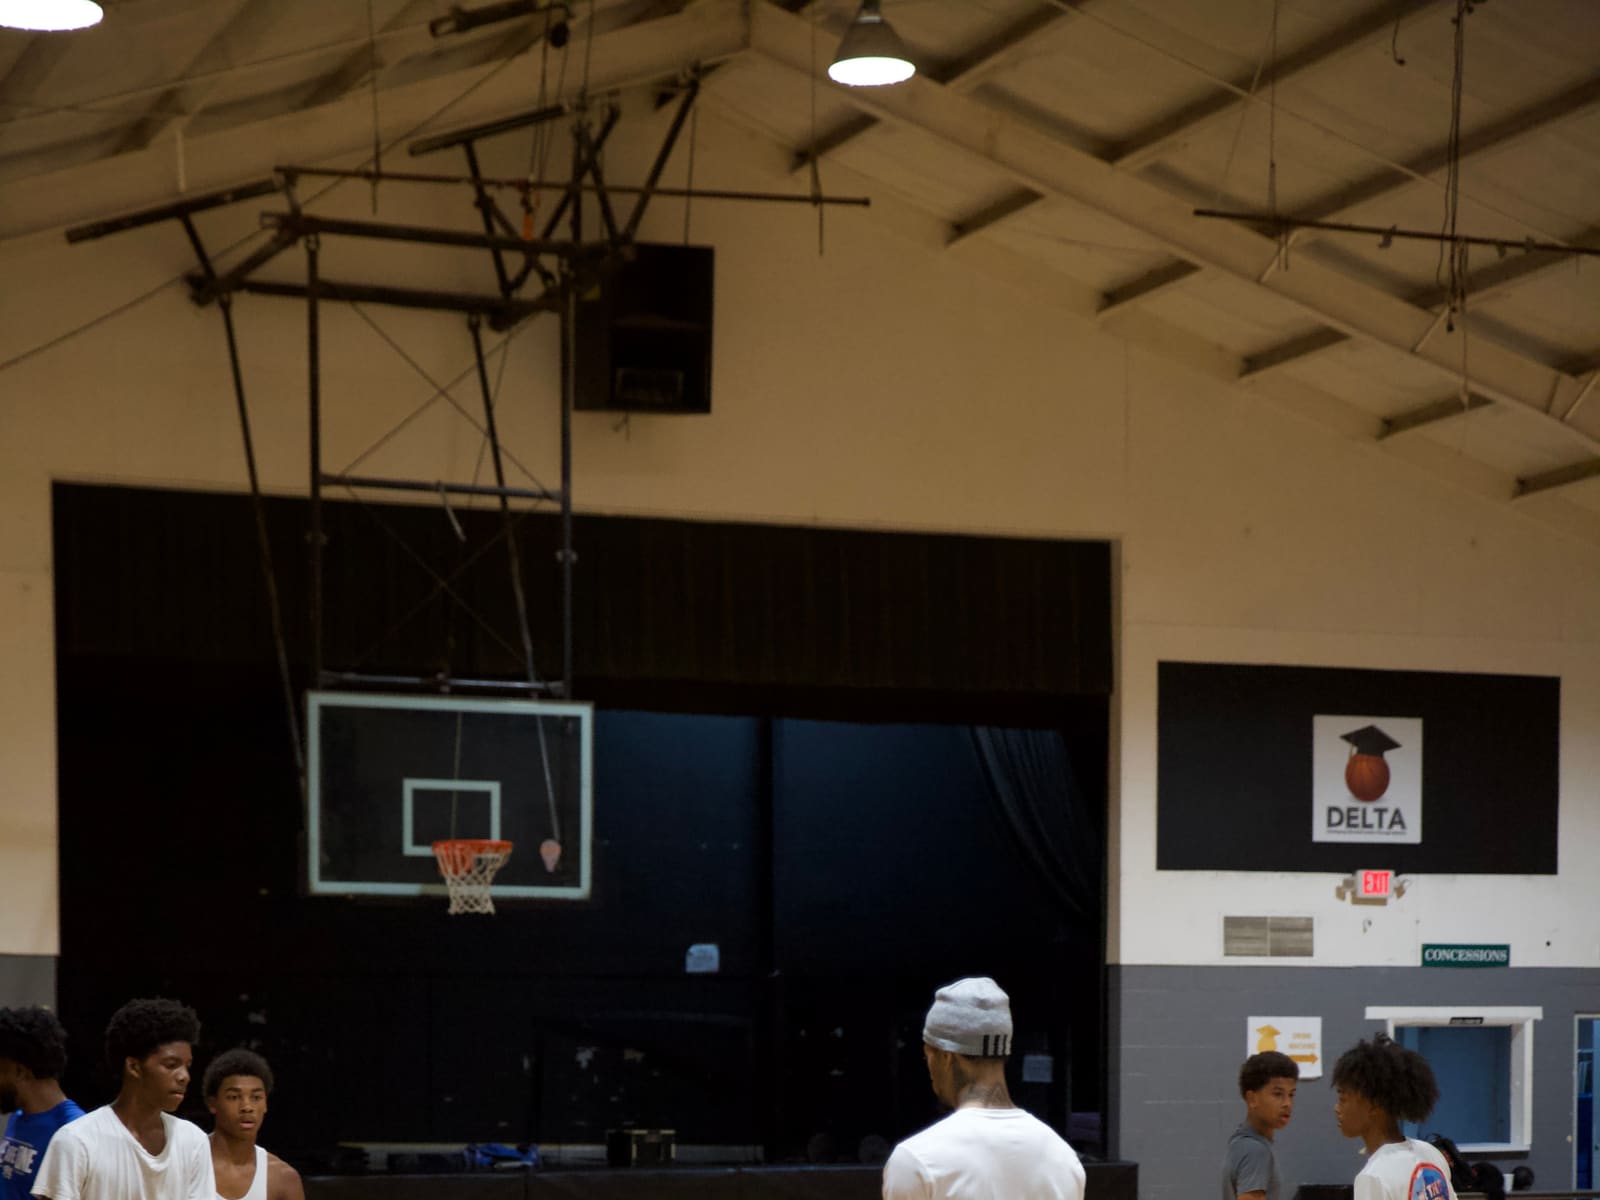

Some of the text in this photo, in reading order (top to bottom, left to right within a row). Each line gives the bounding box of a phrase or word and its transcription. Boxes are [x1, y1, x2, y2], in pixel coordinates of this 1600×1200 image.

[1326, 806, 1407, 830] DELTA
[1363, 870, 1390, 895] EXIT
[1424, 948, 1507, 962] CONCESSIONS
